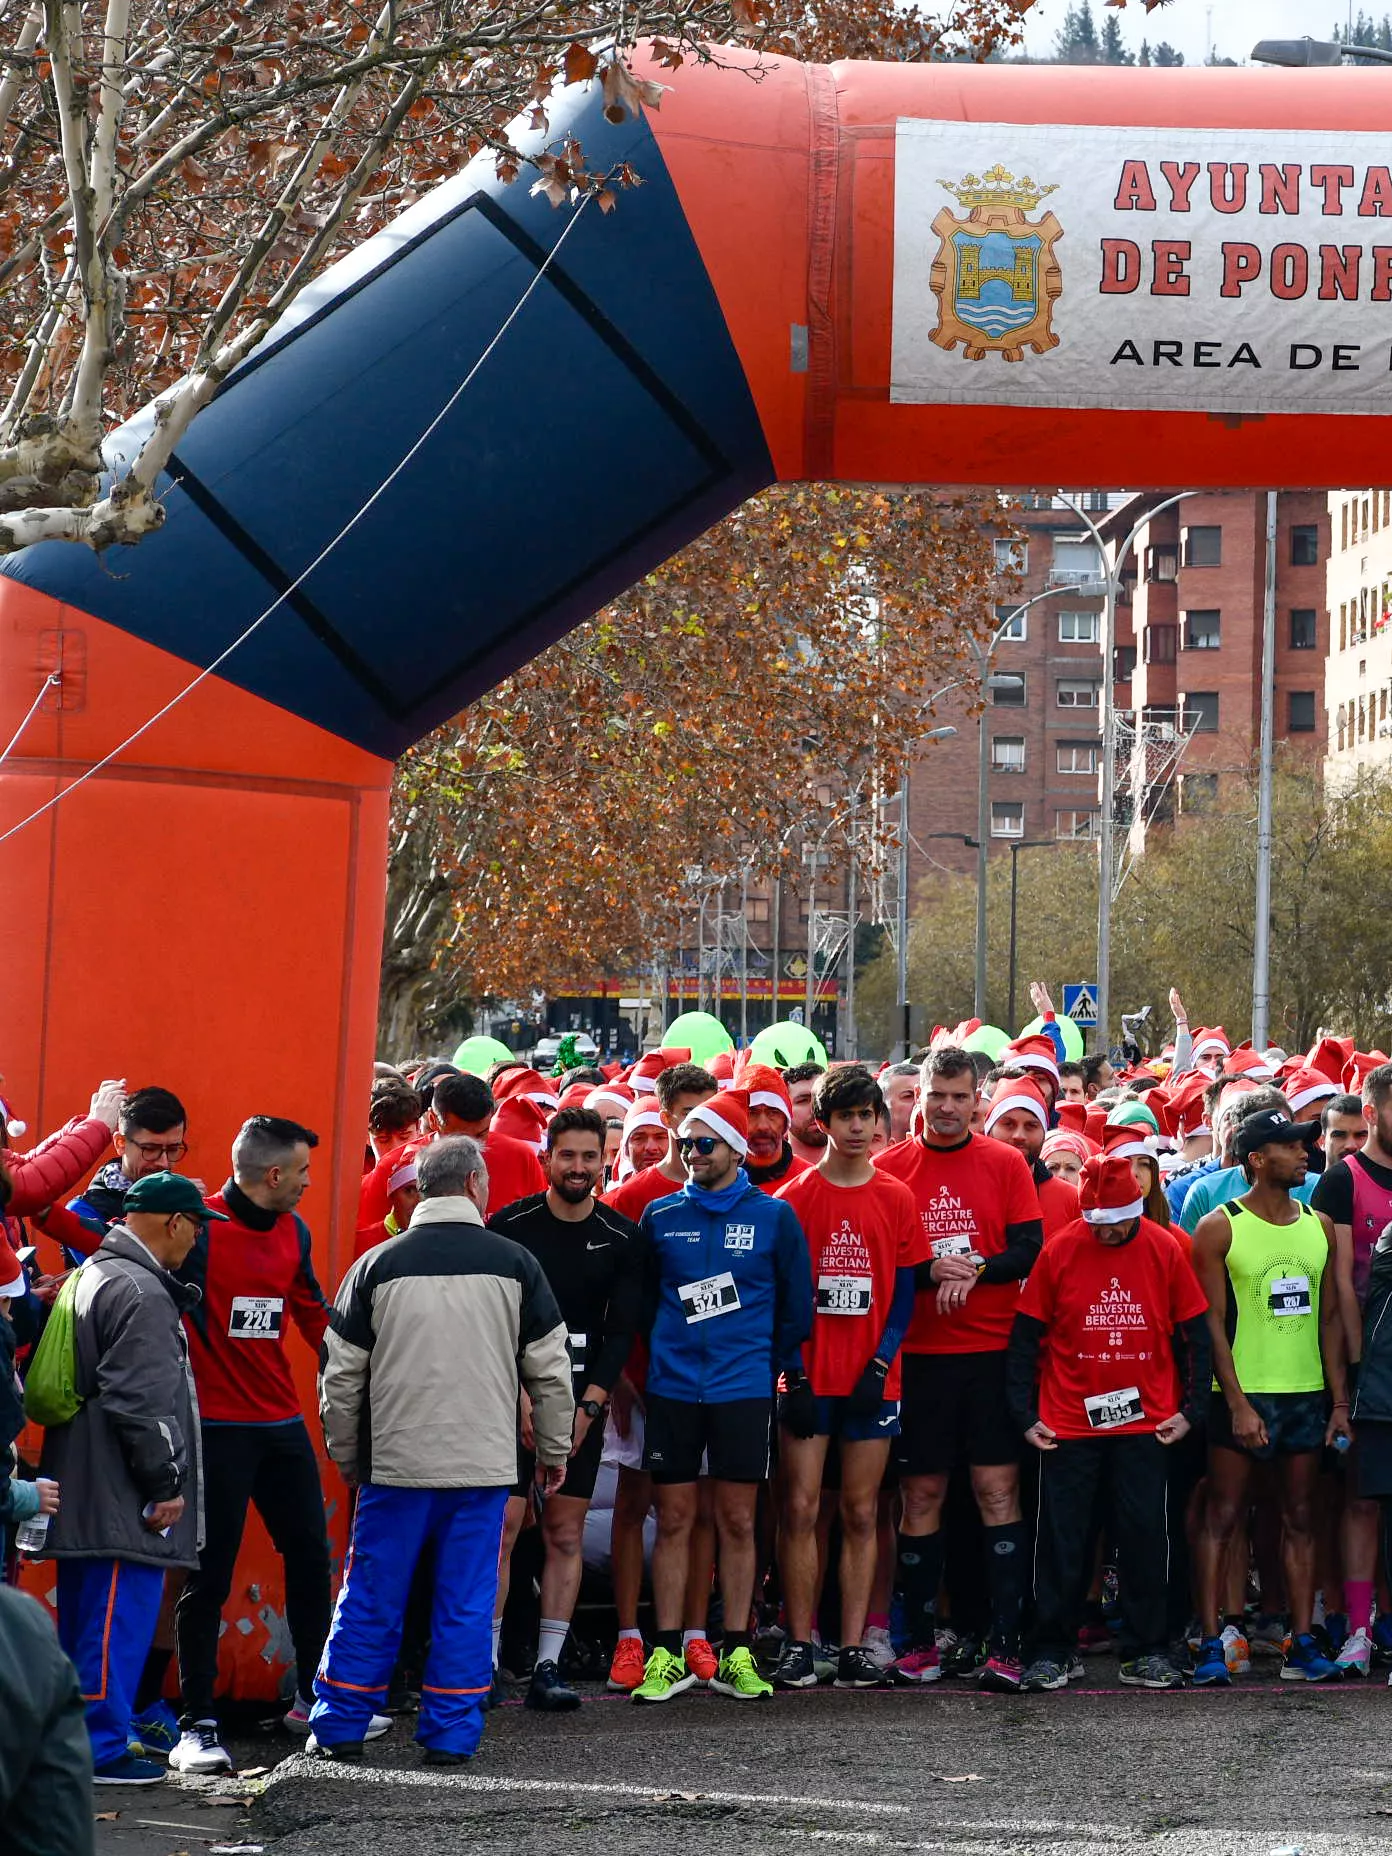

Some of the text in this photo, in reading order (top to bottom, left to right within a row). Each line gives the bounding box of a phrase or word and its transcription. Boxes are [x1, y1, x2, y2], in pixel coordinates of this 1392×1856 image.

[1099, 239, 1192, 296] DE
[1109, 340, 1262, 373] AREA
[1288, 344, 1359, 373] DE
[929, 1197, 961, 1210] SAN
[923, 1220, 977, 1232] ERCIANA
[831, 1232, 861, 1246] SAN
[819, 1257, 871, 1269] ERCIANA
[692, 1290, 723, 1315] 527
[828, 1290, 861, 1309] 389
[1100, 1290, 1131, 1303] SAN
[1089, 1303, 1142, 1315] SILVESTRE
[242, 1310, 272, 1330] 224
[1085, 1314, 1146, 1326] BERCIANA
[1100, 1403, 1132, 1422] 455
